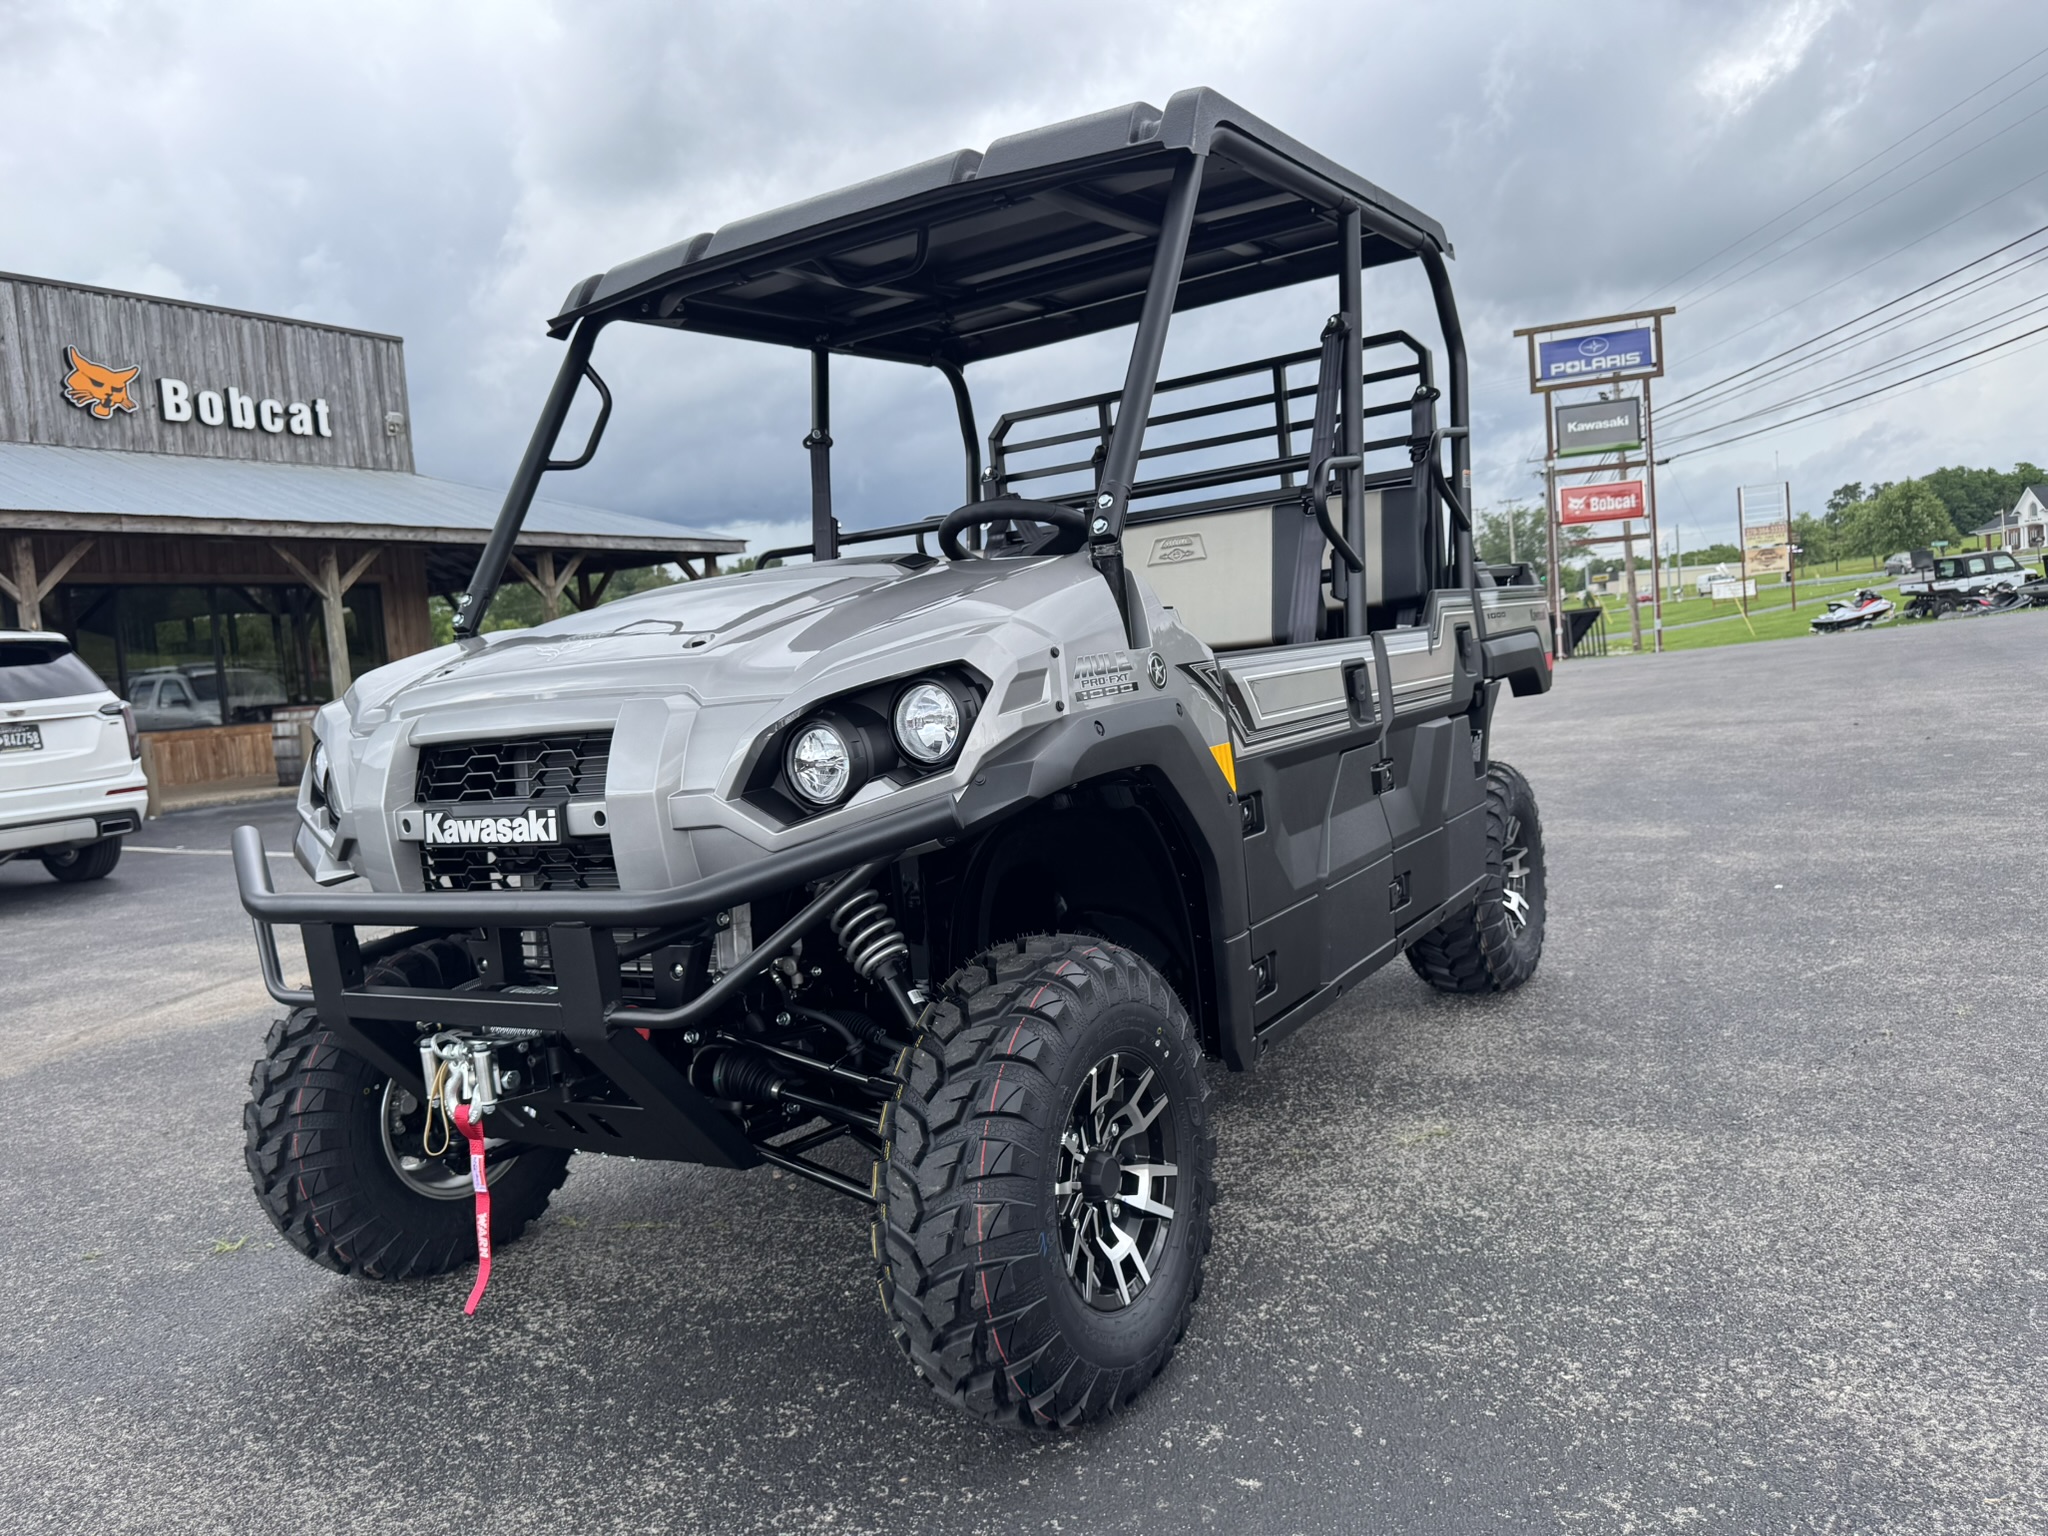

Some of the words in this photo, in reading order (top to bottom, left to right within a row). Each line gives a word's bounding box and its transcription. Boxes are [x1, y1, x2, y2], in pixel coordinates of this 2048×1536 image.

[1550, 352, 1641, 376] POLARIS
[158, 377, 332, 437] Bobcat
[1567, 415, 1629, 433] Kawasaki
[1590, 494, 1636, 512] Bobcat
[1073, 650, 1134, 680] MULE
[1081, 683, 1134, 700] 1000
[424, 809, 558, 844] Kawasaki
[476, 1212, 489, 1259] WARN
